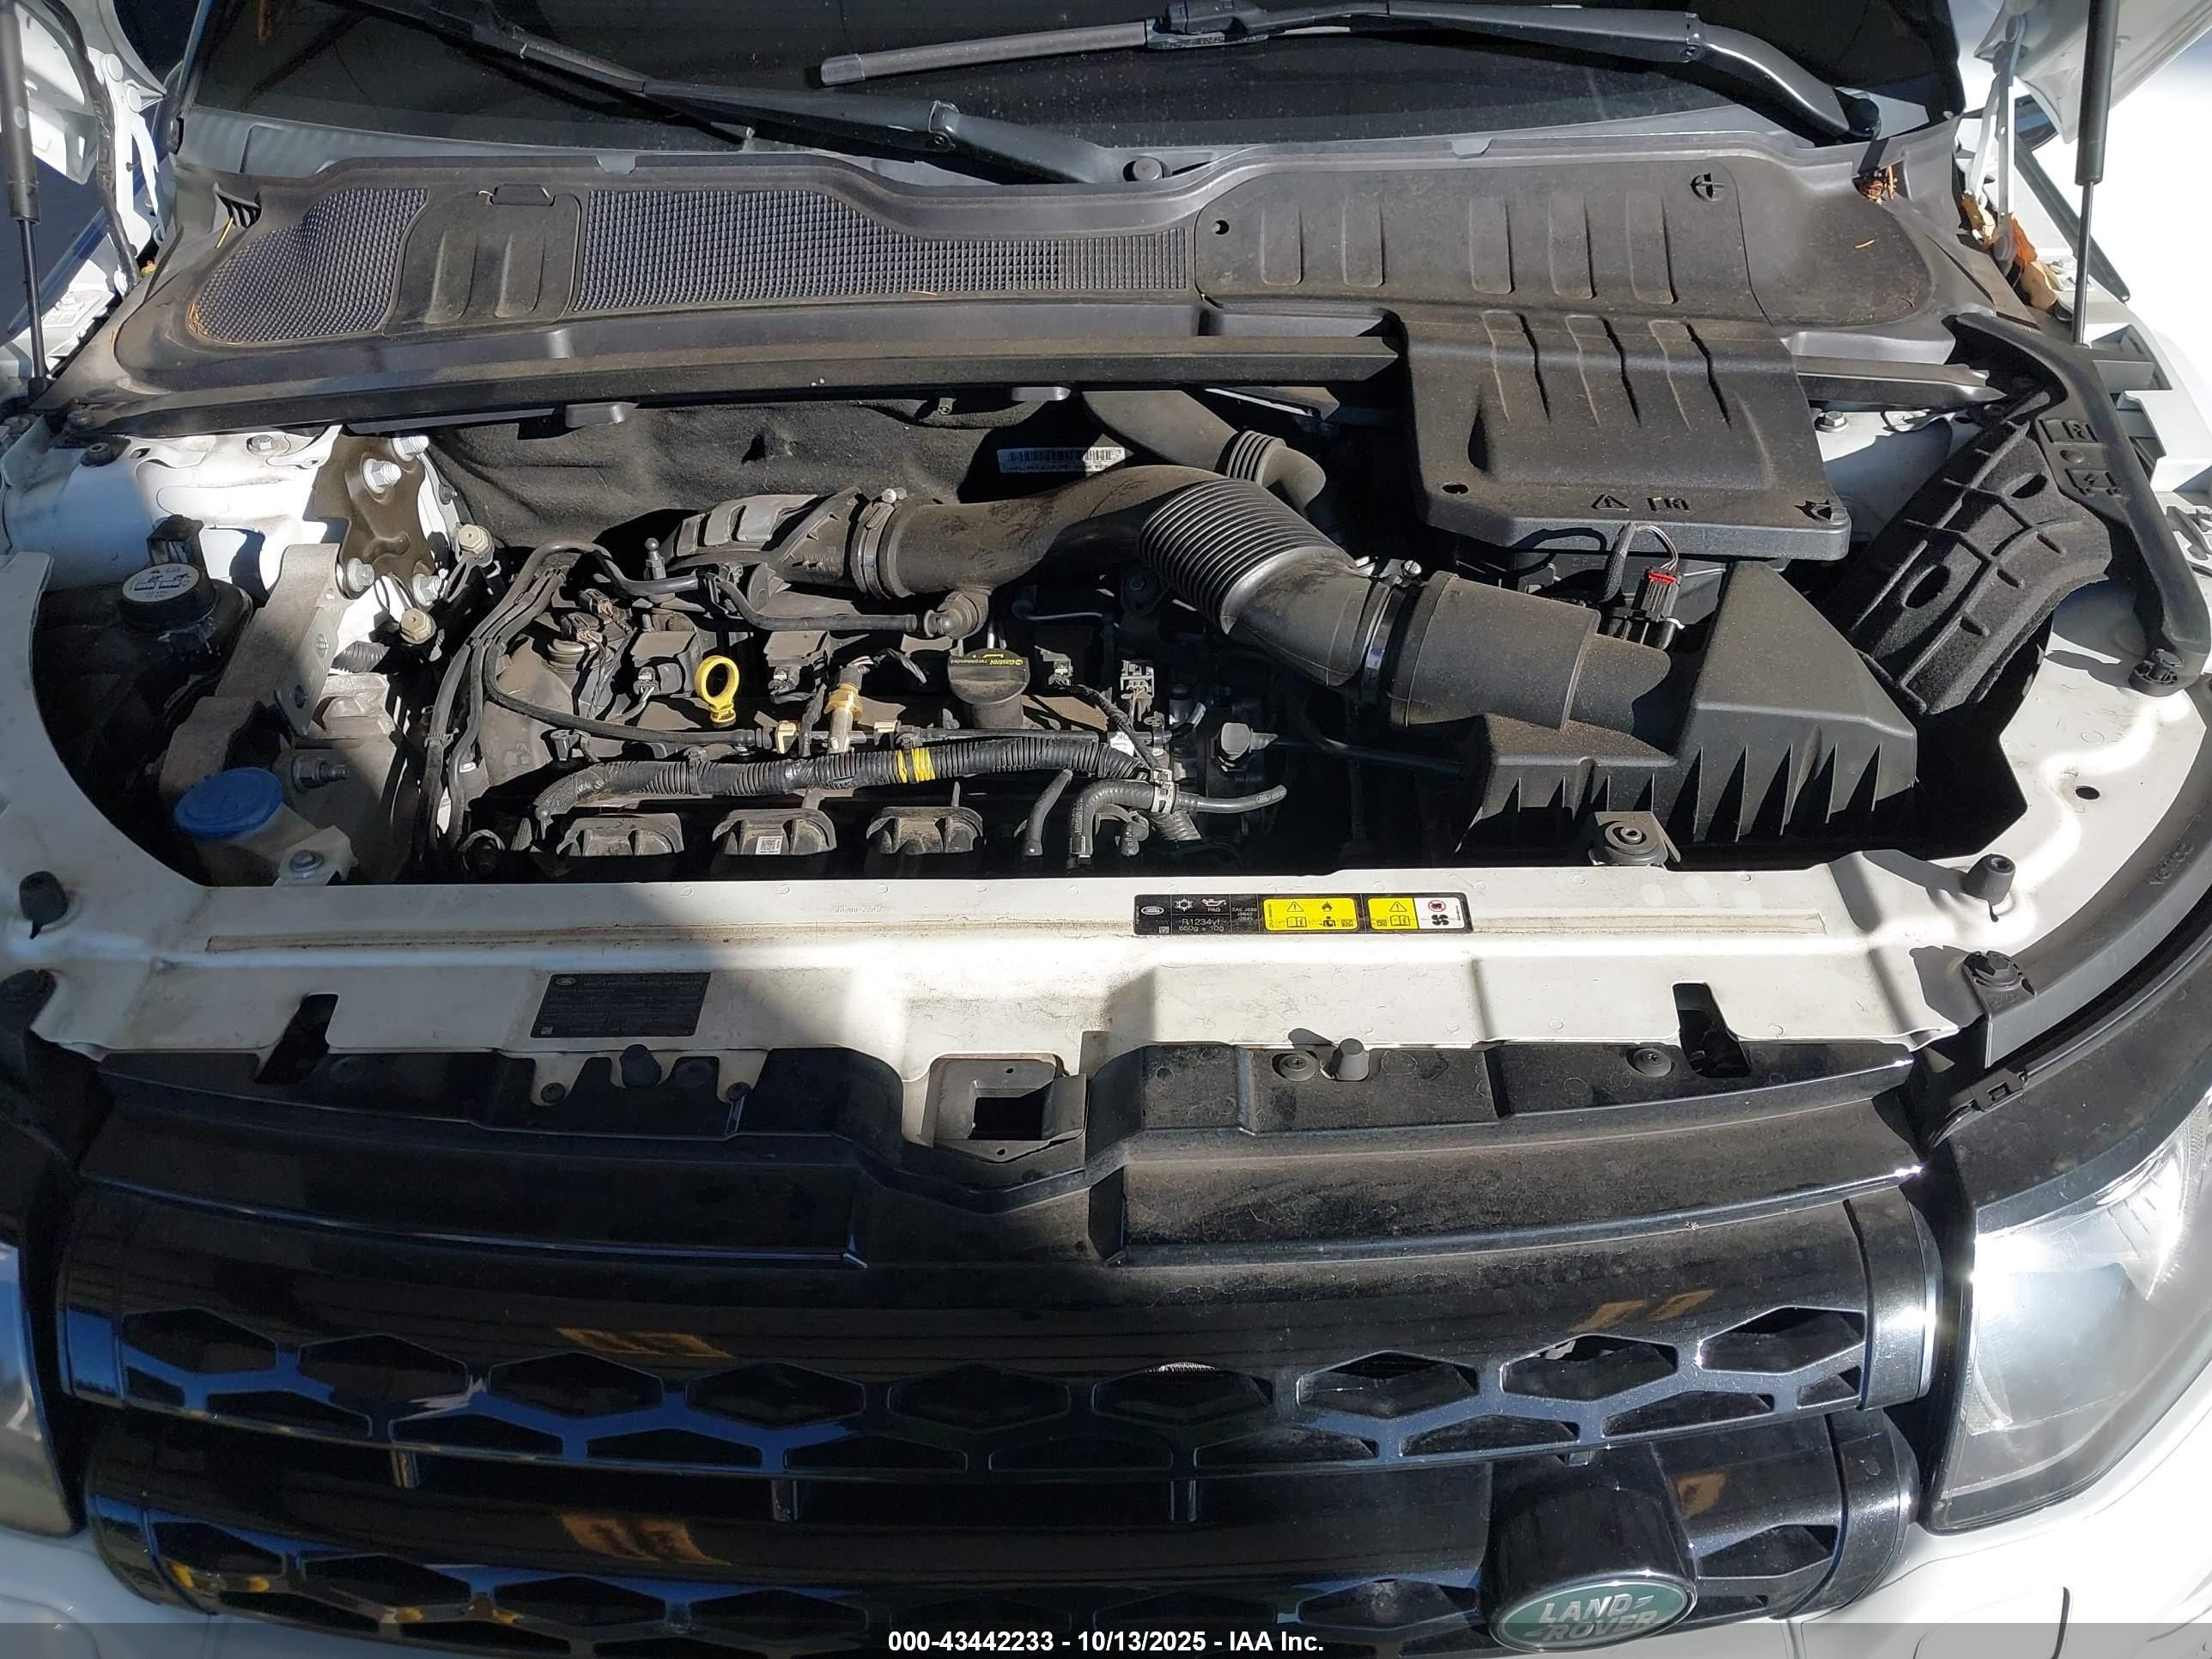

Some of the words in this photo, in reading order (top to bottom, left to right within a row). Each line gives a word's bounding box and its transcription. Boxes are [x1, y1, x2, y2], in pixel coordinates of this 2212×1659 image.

[1182, 918, 1221, 927] R1234yf
[1539, 1593, 1632, 1623] LAND
[1544, 1610, 1658, 1641] ROVER
